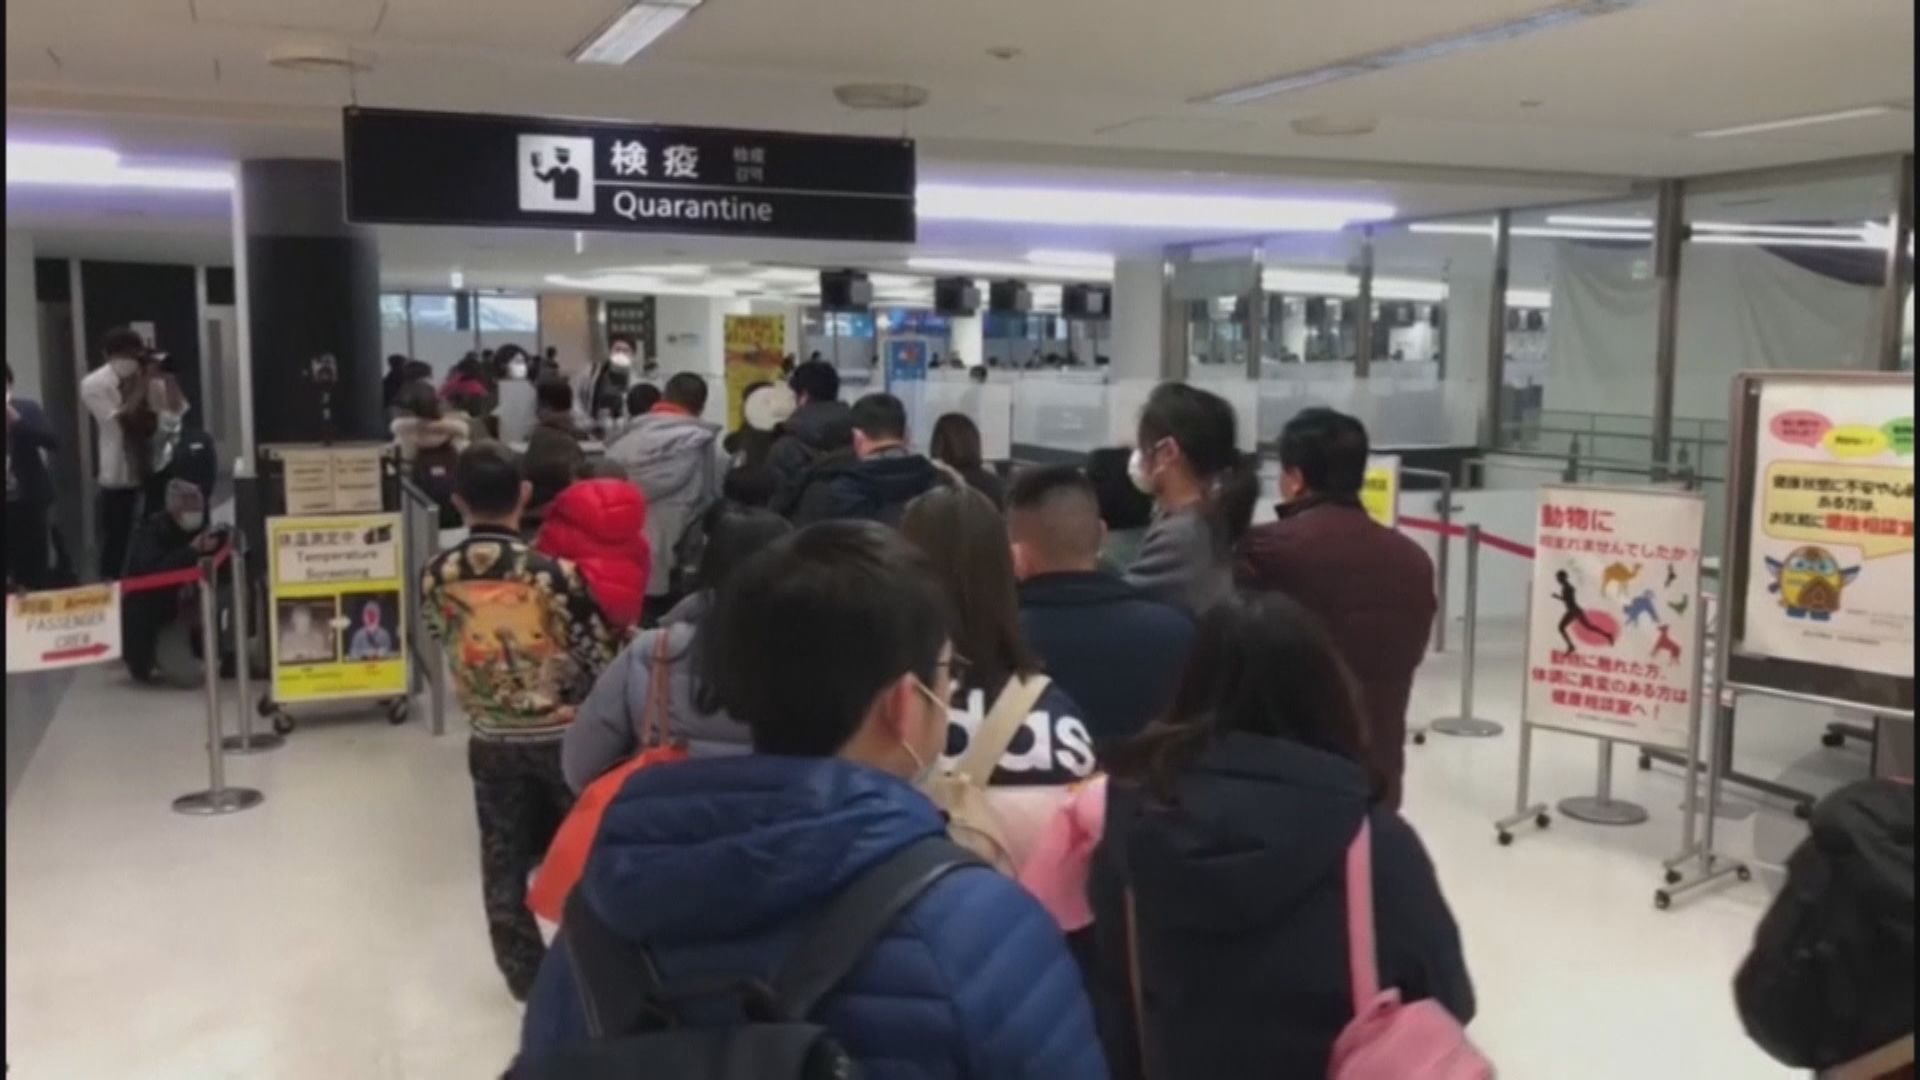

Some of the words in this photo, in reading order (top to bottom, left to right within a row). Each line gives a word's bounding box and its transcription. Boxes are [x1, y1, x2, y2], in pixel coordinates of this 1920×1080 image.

[610, 139, 698, 178] 検疫
[613, 190, 773, 222] Quarantine
[1541, 503, 1615, 533] 動物に
[296, 550, 378, 563] Temperature
[306, 567, 370, 580] Screening
